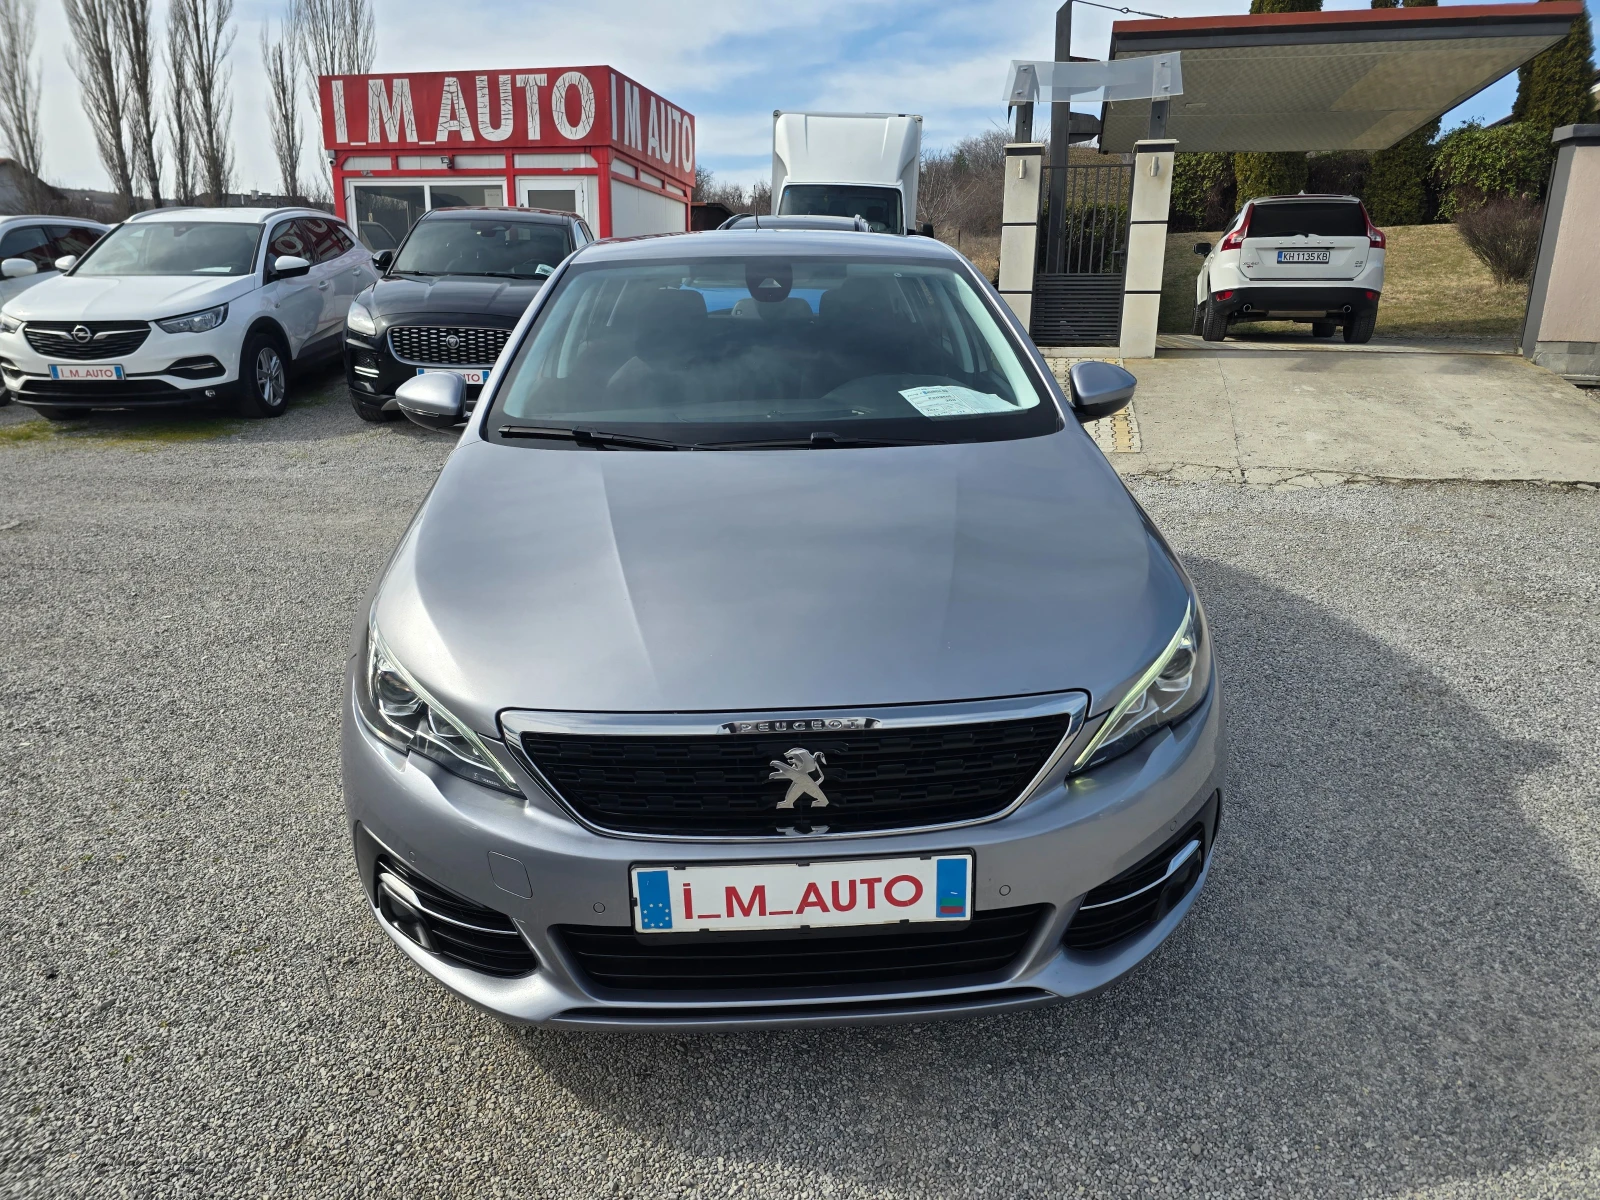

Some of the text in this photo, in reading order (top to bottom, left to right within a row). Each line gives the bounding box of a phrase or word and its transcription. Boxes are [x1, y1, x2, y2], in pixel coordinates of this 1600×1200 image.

[610, 73, 693, 173] I M AUTO
[1283, 252, 1328, 261] KH 1135 KB
[740, 718, 860, 733] PEUGEOT
